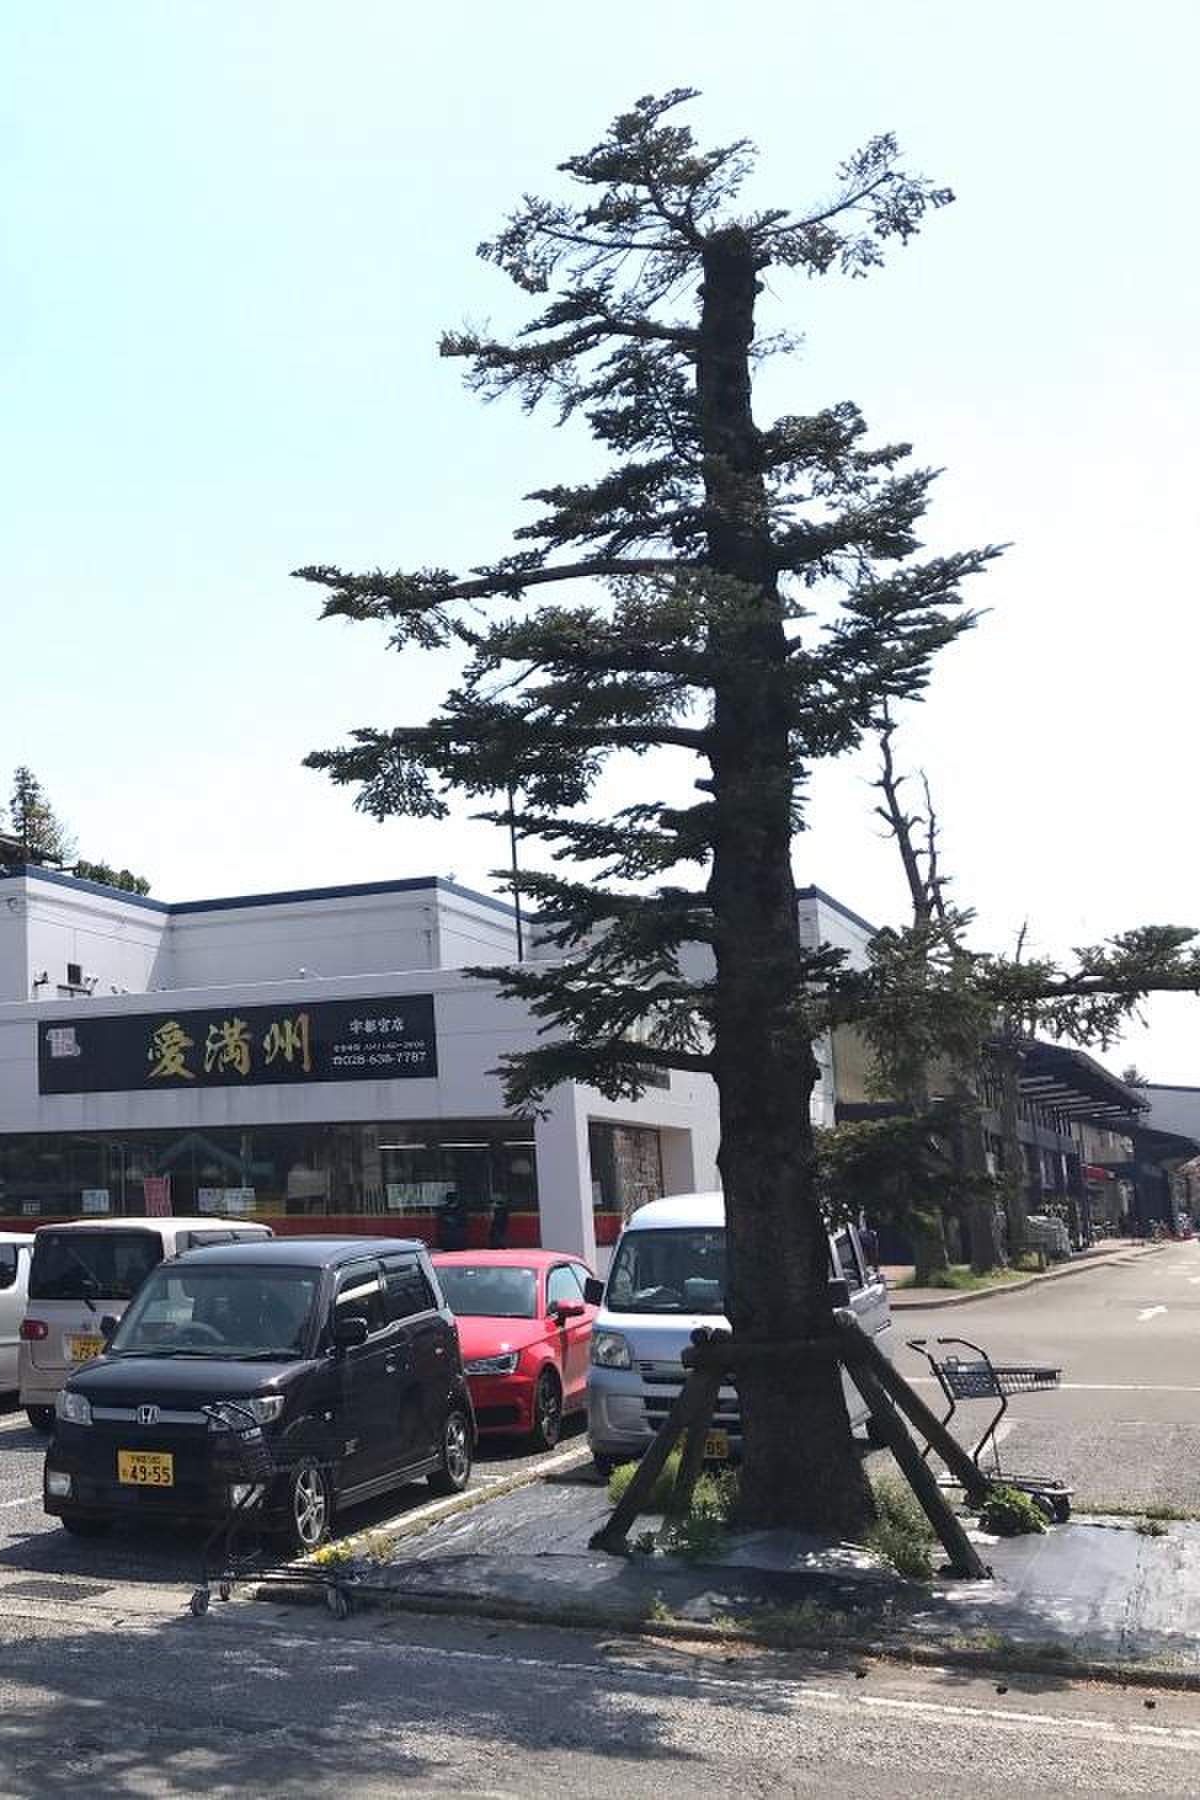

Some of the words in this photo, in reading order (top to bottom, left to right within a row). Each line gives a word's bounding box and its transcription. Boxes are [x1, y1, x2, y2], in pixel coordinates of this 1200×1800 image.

[145, 1012, 313, 1080] 愛満州
[130, 1465, 171, 1483] 49-55
